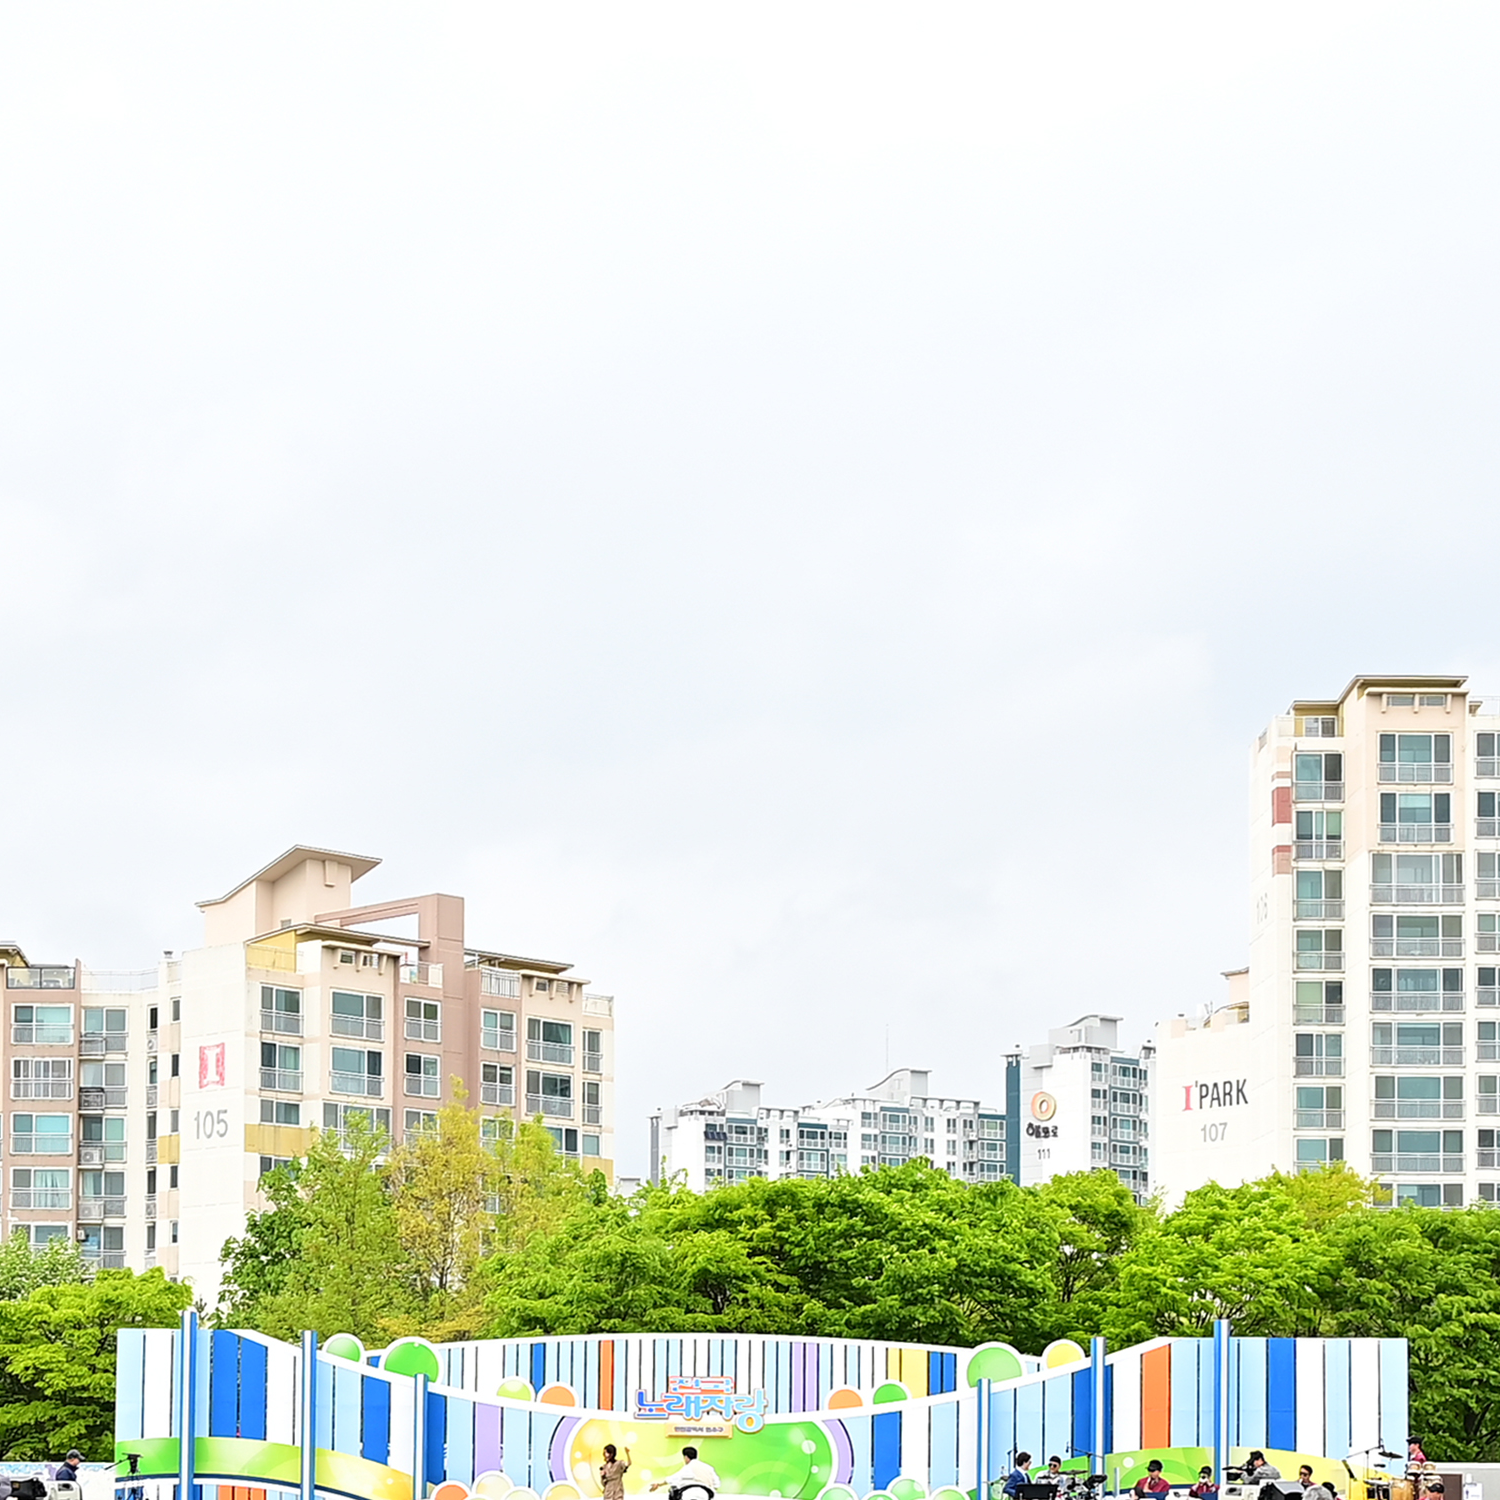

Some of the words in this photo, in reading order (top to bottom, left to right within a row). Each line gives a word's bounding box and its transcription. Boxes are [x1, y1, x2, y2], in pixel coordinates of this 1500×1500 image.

[1182, 1078, 1248, 1112] I'PARK
[194, 1109, 228, 1140] 105
[1201, 1122, 1228, 1143] 107
[1037, 1148, 1050, 1160] 111
[670, 1378, 733, 1394] 전국
[636, 1389, 767, 1432] 노래자랑
